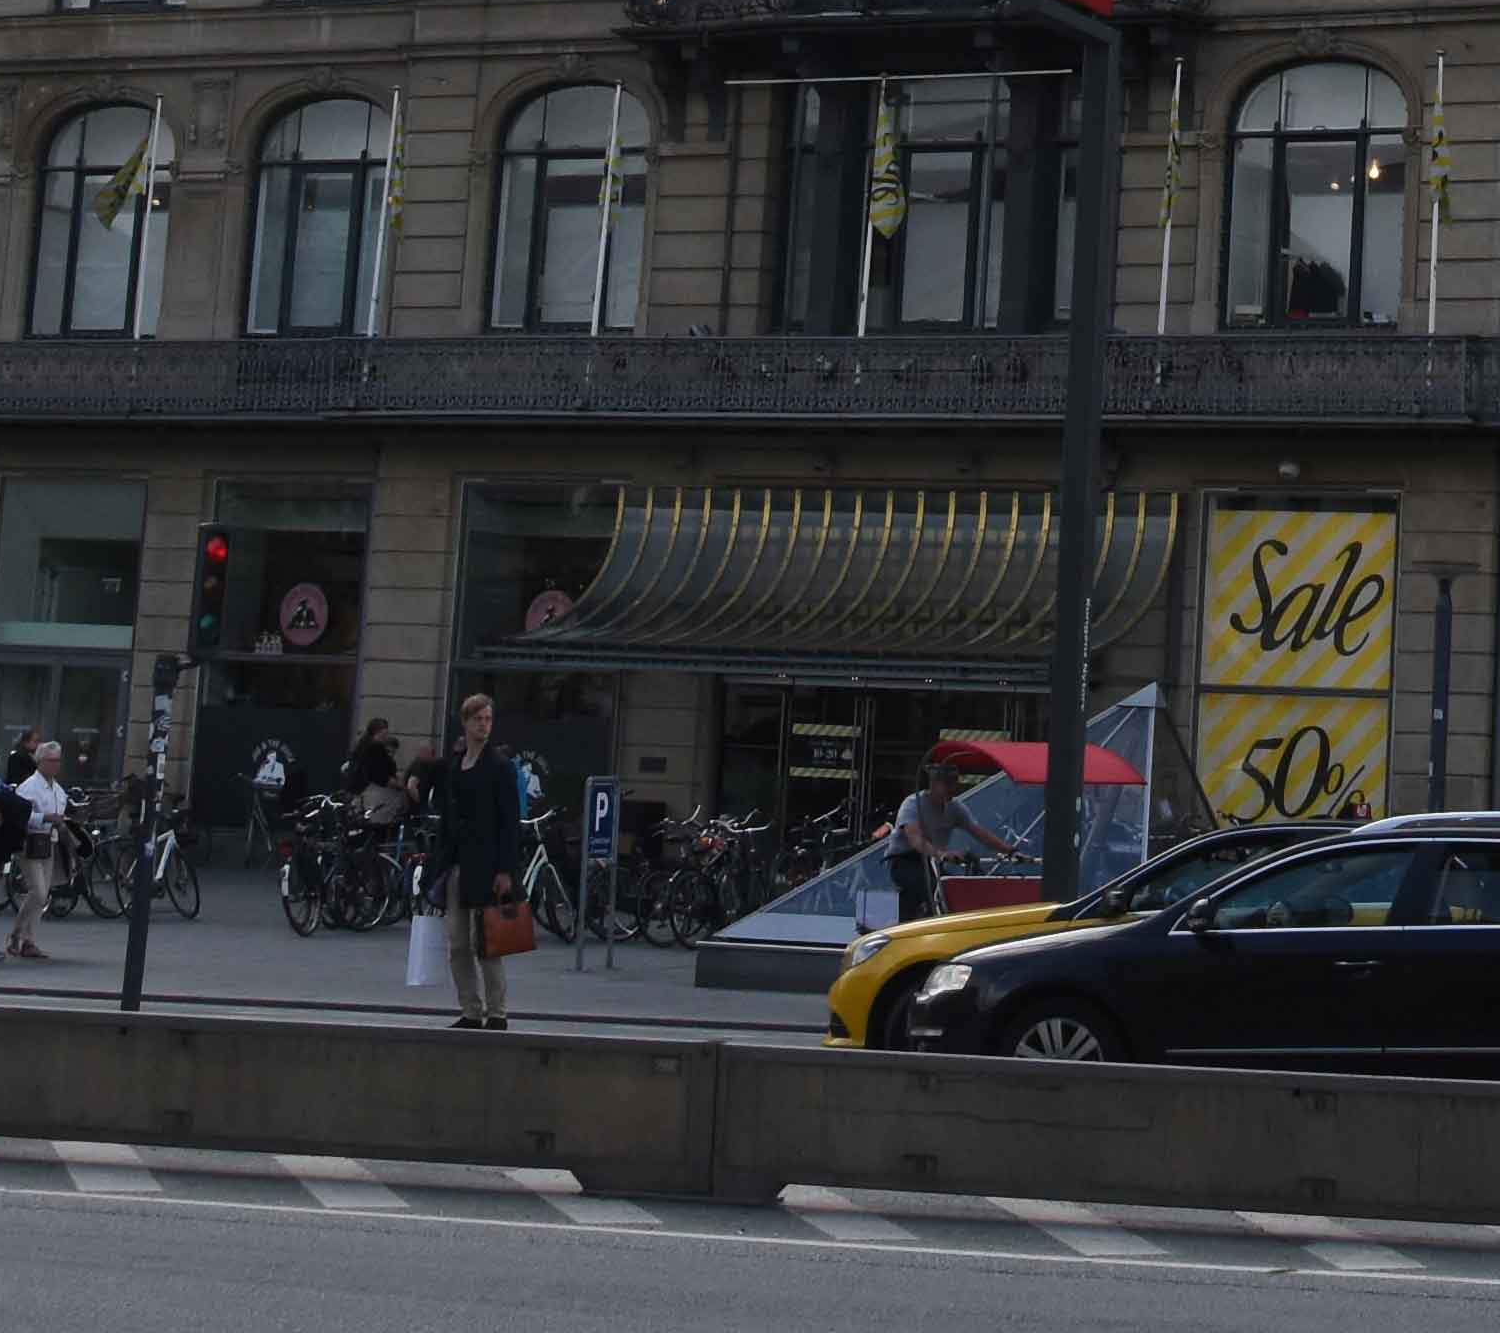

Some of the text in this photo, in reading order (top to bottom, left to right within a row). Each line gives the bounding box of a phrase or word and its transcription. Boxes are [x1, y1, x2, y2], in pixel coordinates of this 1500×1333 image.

[1230, 539, 1385, 656] Sale
[596, 792, 609, 832] P
[1228, 726, 1365, 822] 50%
